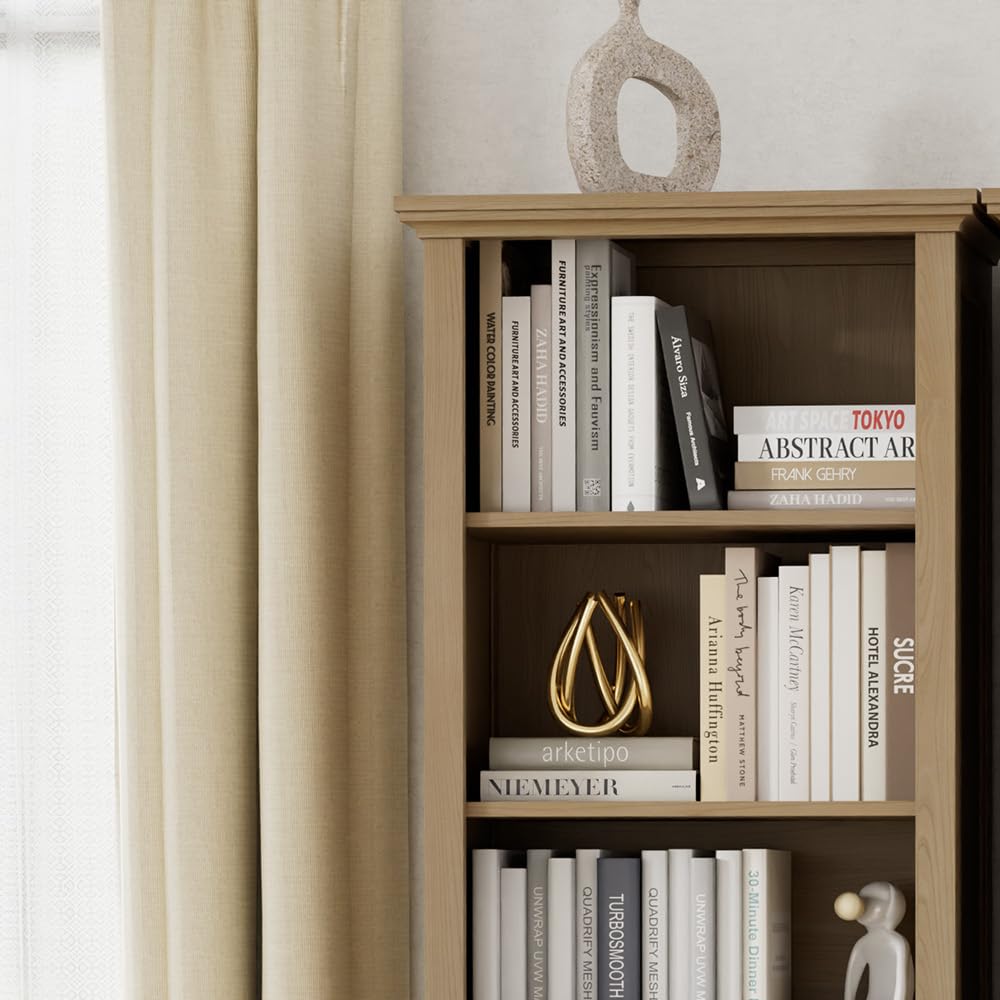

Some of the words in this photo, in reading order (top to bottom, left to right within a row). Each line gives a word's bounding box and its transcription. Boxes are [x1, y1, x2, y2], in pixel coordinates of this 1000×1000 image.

[486, 312, 496, 344] WATER
[589, 265, 602, 362] Expressionism
[486, 346, 496, 380] COLOR
[536, 328, 547, 371] ZAHA
[671, 335, 684, 373] Álvaro
[678, 376, 688, 399] Siza
[536, 375, 547, 424] HADID
[591, 368, 602, 392] and
[486, 381, 496, 426] PAINTING
[591, 396, 602, 451] Fauvism
[766, 410, 799, 432] ART
[803, 410, 849, 431] SPACE
[852, 409, 906, 430] TOKYO
[758, 436, 879, 459] ABSTRACT
[771, 467, 813, 481] FRANK
[816, 467, 857, 480] GEHRY
[769, 494, 811, 506] ZAHA
[815, 493, 863, 506] HADID
[734, 569, 749, 600] The
[788, 585, 804, 622] Karen
[708, 616, 723, 675] Arianna
[784, 626, 804, 692] McCartney
[868, 627, 879, 668] HOTEL
[893, 637, 914, 694] SUCRE
[727, 647, 750, 697] beyond
[704, 681, 723, 764] Huffington
[868, 671, 879, 748] ALEXANDRA
[542, 741, 629, 767] arketipo
[488, 778, 619, 796] NIEMEYER
[533, 886, 544, 947] UNWRAP
[583, 886, 593, 957] QUADRIFY
[648, 888, 658, 958] QUADRIFY
[696, 894, 706, 953] UNWRAP
[749, 870, 760, 941] 30-Minute
[533, 951, 544, 983] UVW
[609, 893, 624, 998] TURBOSMOOTH
[583, 961, 593, 1000] MESH
[648, 962, 658, 1000] MESH
[696, 956, 706, 987] UVW
[749, 945, 760, 993] Dinner
